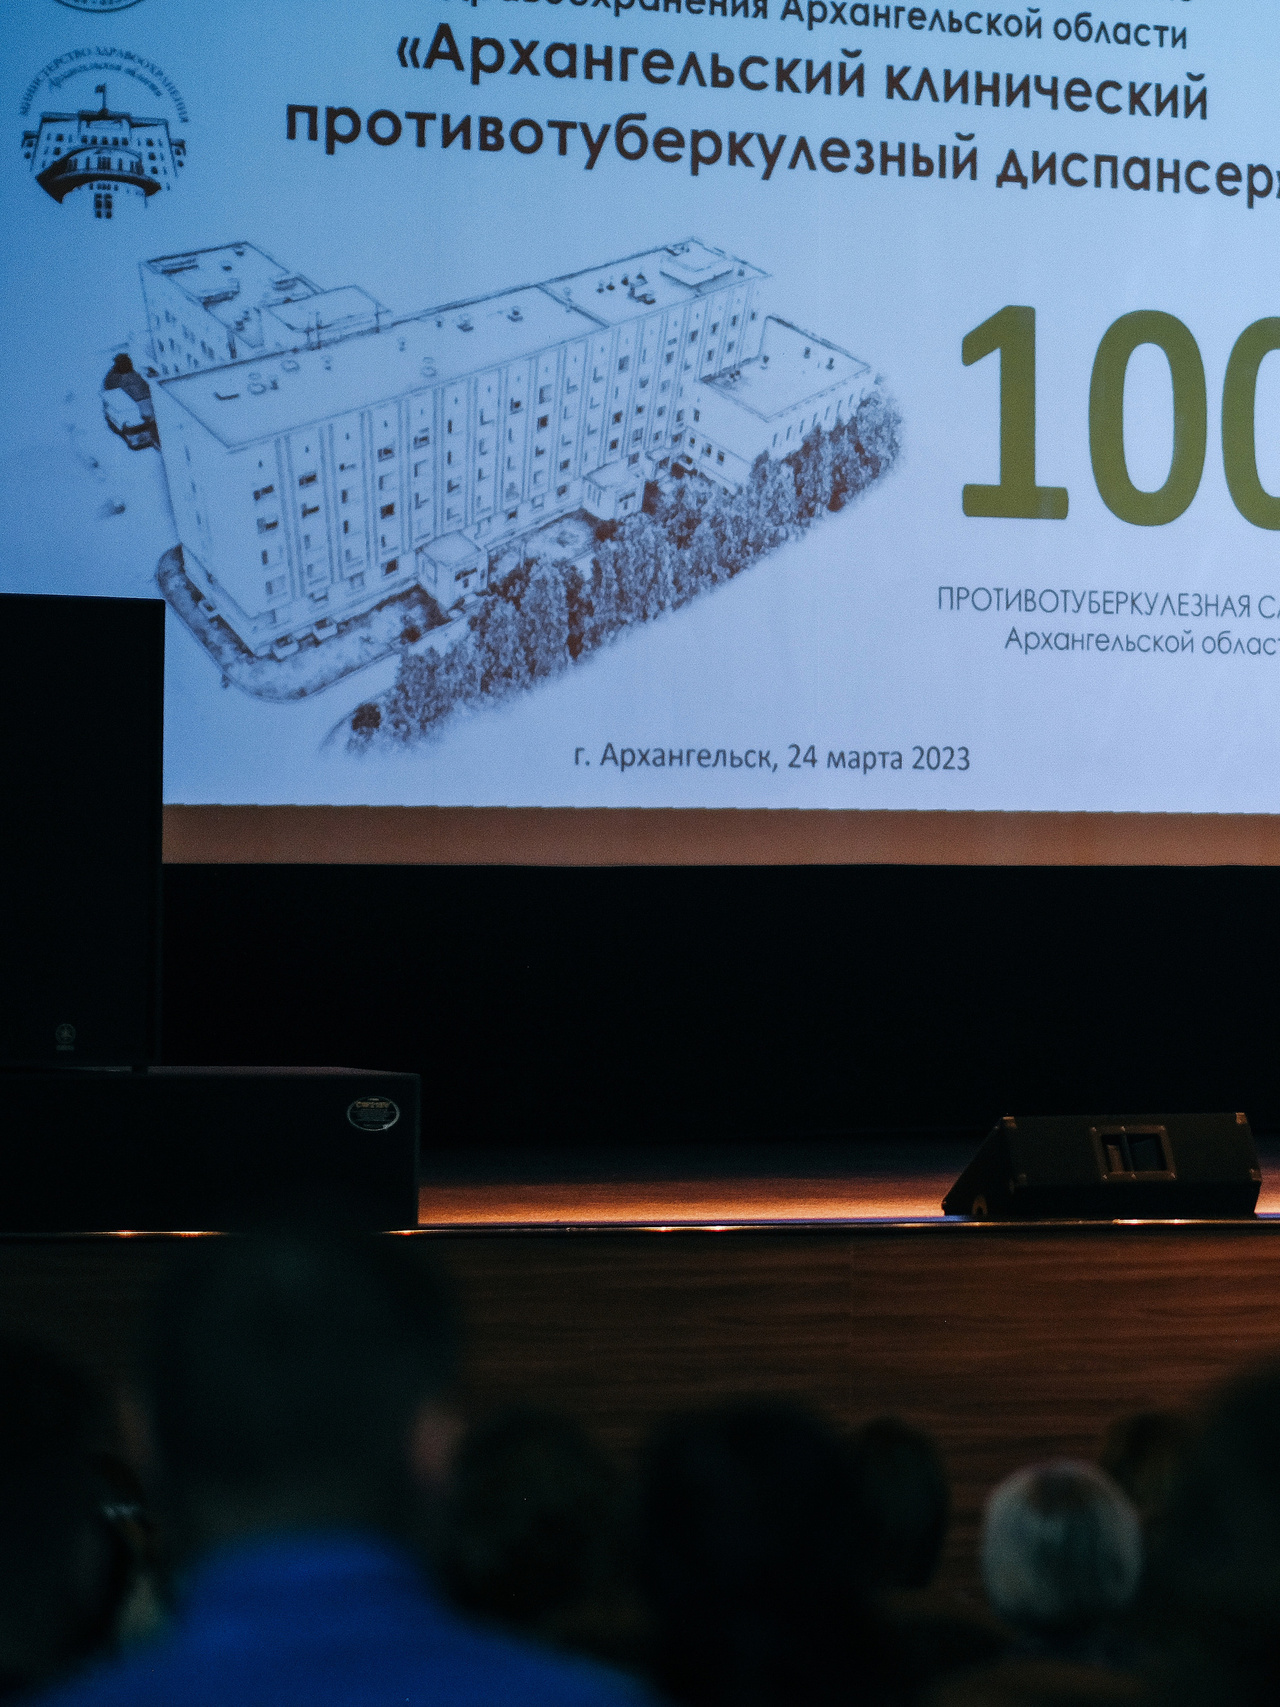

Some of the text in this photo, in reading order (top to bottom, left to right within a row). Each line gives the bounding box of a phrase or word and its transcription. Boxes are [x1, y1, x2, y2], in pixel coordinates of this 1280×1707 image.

[780, 0, 1042, 39] Архангельской
[1053, 11, 1188, 49] области
[396, 22, 1208, 120] «Архангельский клинический
[286, 104, 978, 181] противотуберкулезный
[938, 586, 1251, 617] ПРОТИВОТУБЕРКУЛЕЗНАЯ
[1005, 627, 1194, 655] Архангельской
[574, 742, 971, 775] г. Архангельск, 24 марта 2023
